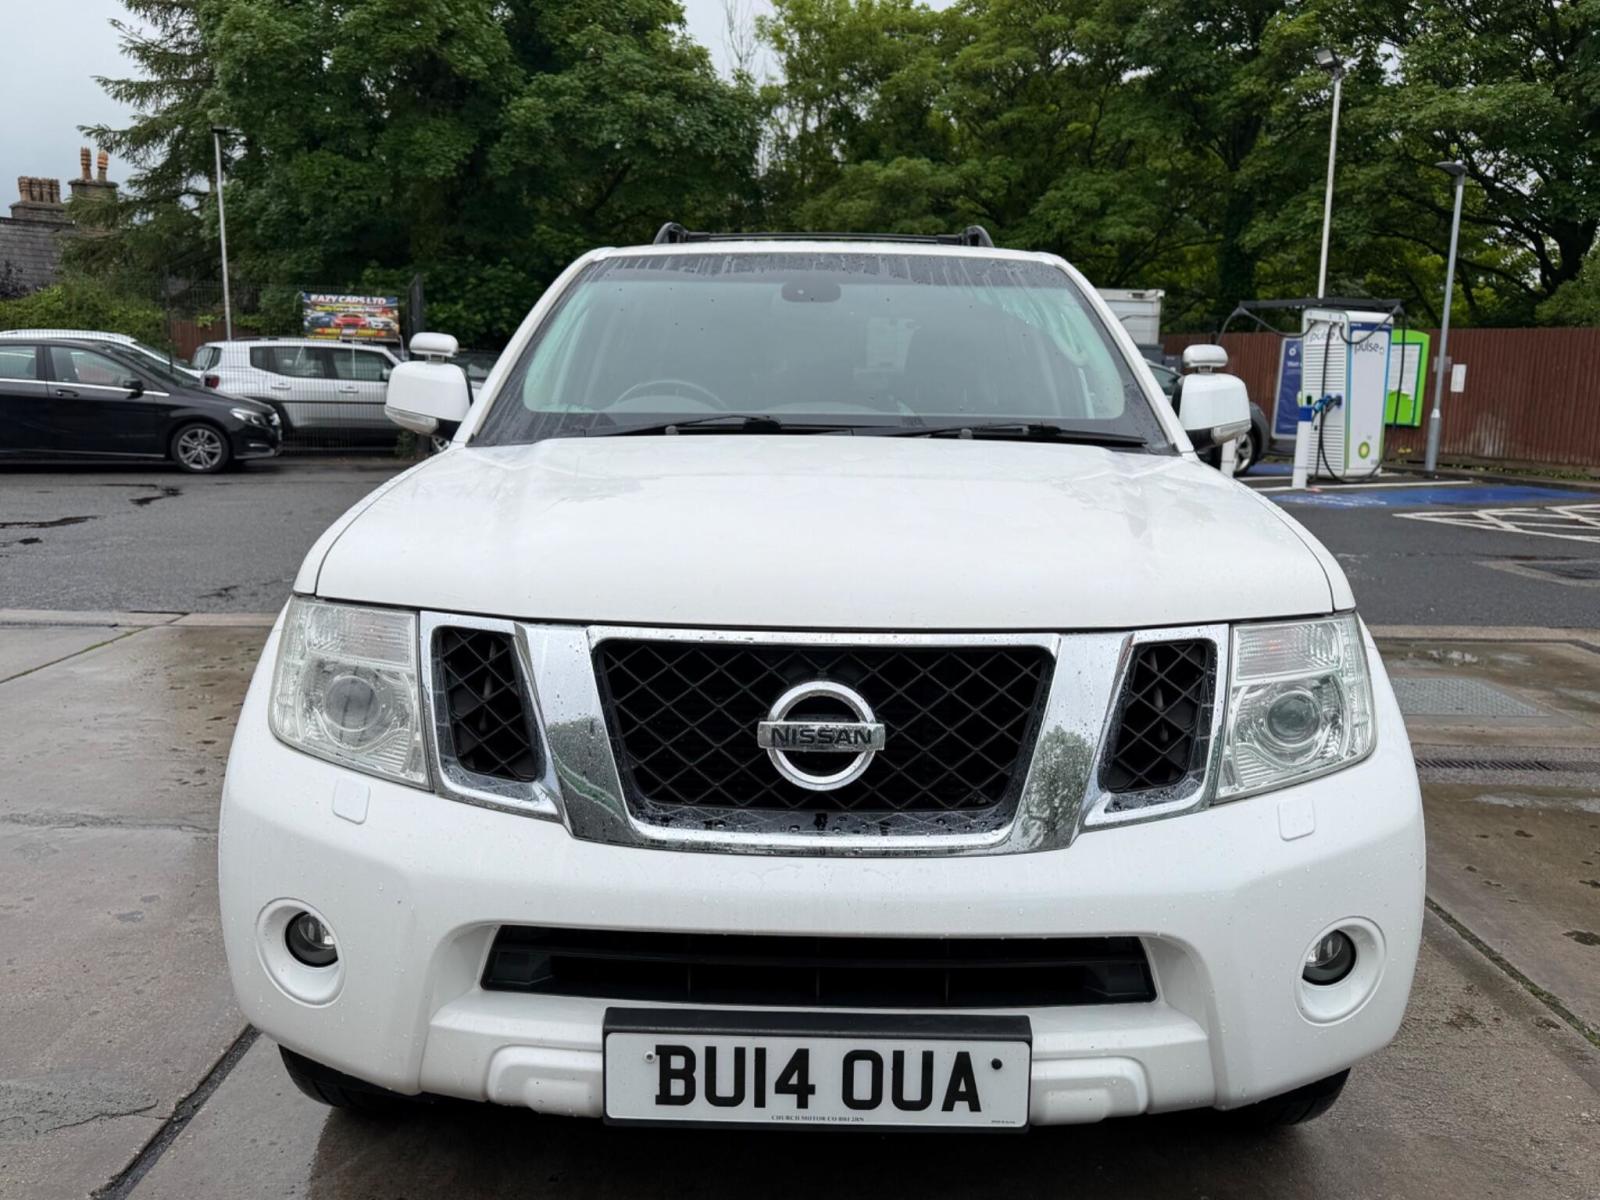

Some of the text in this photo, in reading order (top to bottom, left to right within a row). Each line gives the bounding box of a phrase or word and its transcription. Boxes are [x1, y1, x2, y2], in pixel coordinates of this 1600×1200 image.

[338, 295, 365, 304] CARS
[366, 296, 387, 305] LTD
[1354, 340, 1379, 353] pulse
[771, 727, 872, 745] NISSAN
[655, 1044, 982, 1113] BU14 OUA
